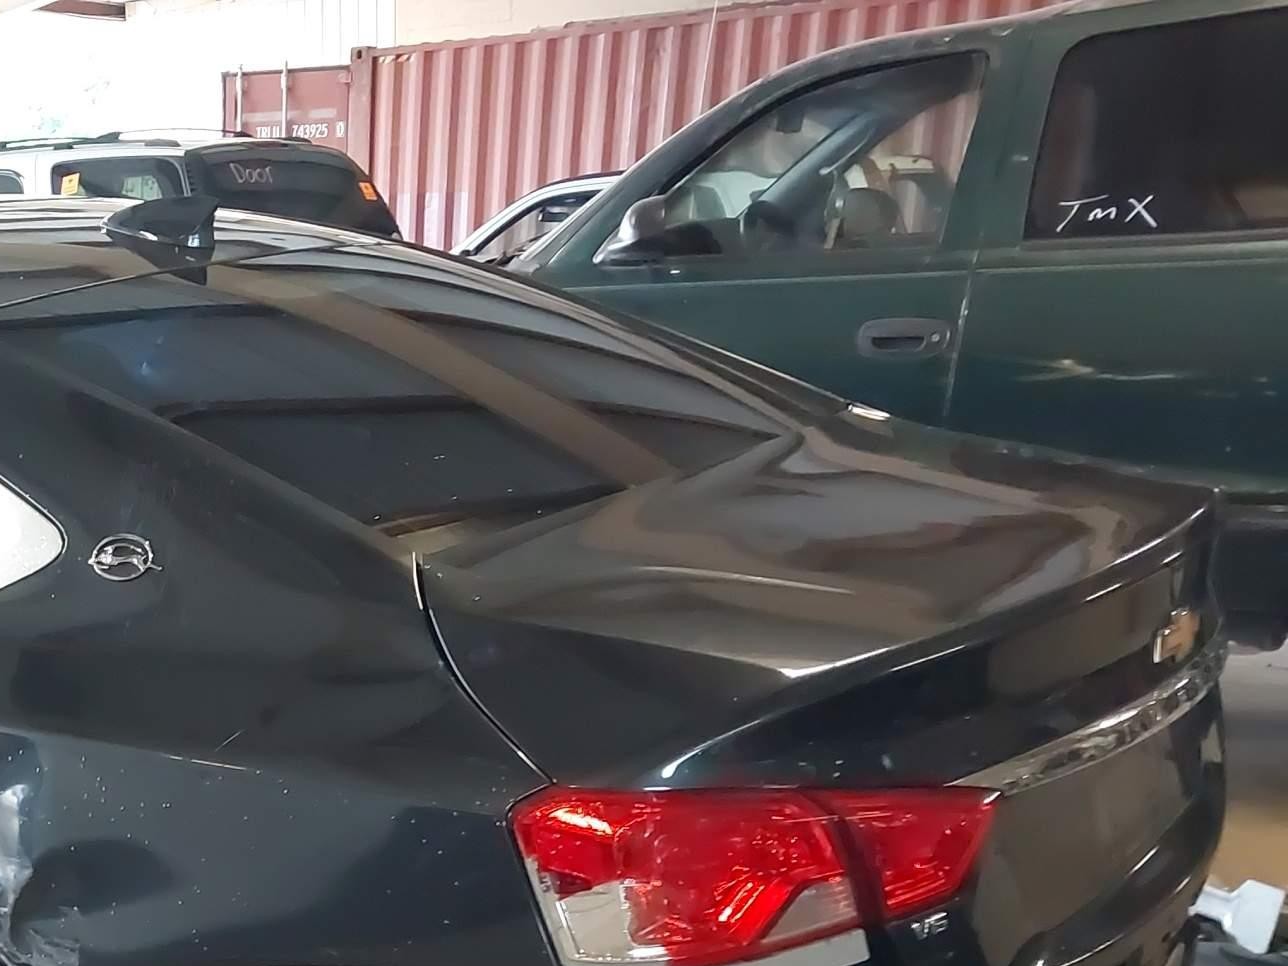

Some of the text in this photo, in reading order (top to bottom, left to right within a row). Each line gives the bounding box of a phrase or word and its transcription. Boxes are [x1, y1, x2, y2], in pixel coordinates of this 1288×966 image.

[292, 123, 328, 138] 743925
[229, 162, 273, 184] Door
[911, 911, 948, 940] V6
